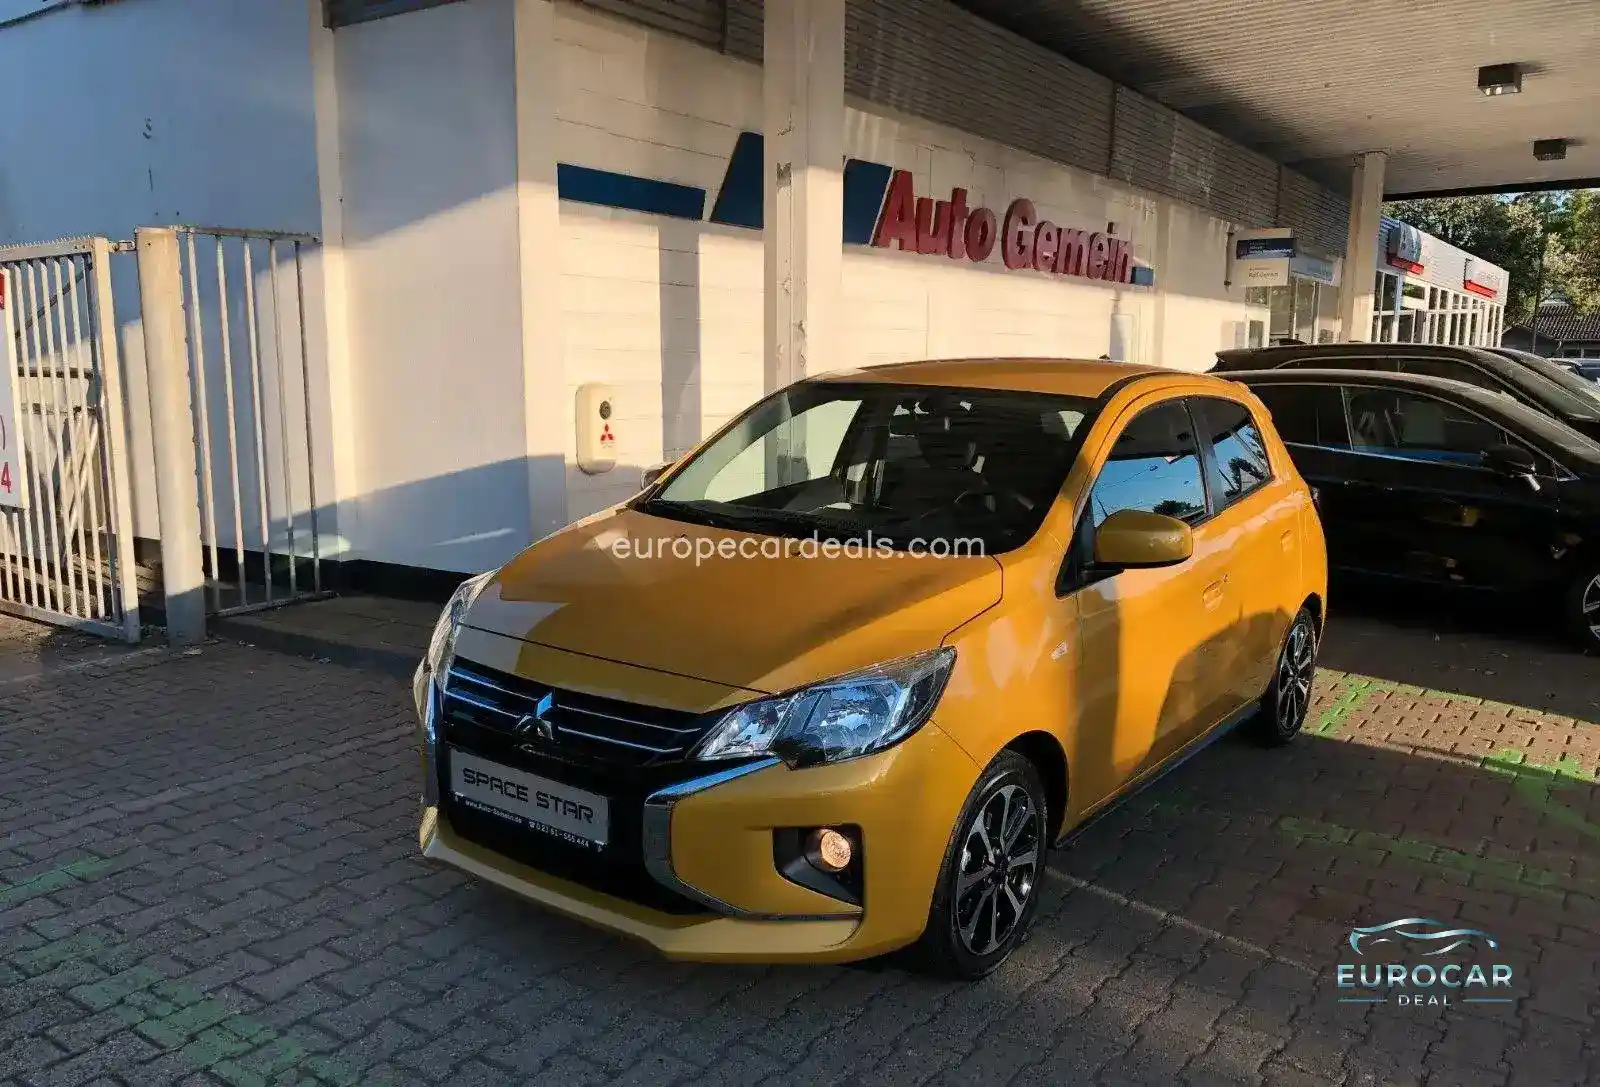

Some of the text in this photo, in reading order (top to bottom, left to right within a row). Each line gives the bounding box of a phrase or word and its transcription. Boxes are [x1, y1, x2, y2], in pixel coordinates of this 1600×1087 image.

[873, 169, 1135, 284] Auto Gemein
[462, 767, 594, 824] SPACE STAR
